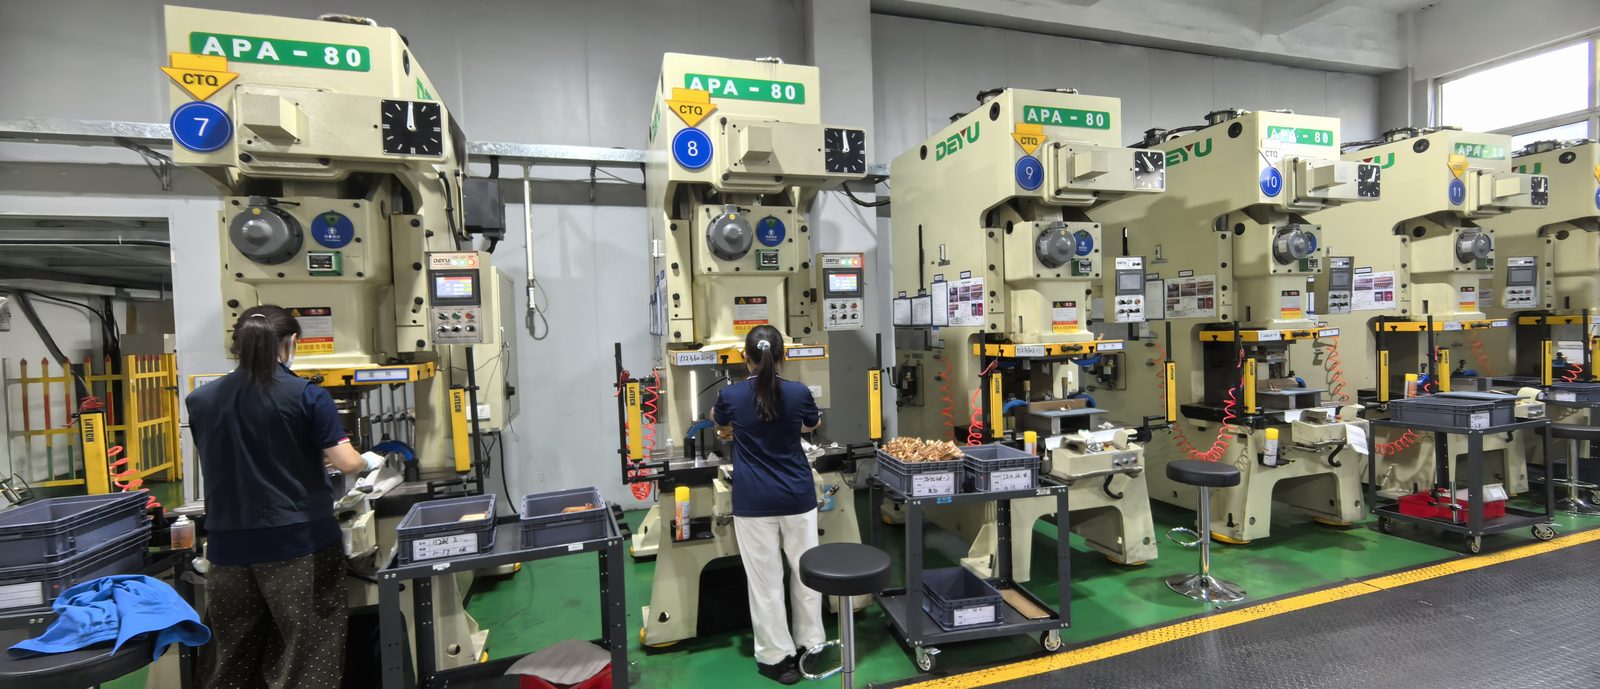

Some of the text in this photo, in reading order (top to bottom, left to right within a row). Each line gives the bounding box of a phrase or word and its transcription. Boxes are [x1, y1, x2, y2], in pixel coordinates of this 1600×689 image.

[202, 36, 280, 62] APA
[324, 46, 361, 67] 80
[182, 73, 219, 88] CTQ
[690, 76, 738, 96] APA
[771, 83, 796, 100] 80
[679, 104, 703, 116] CTQ
[1027, 108, 1063, 124] APA
[1085, 112, 1104, 127] 80
[194, 117, 210, 137] 7
[936, 121, 980, 162] DEYU
[1020, 136, 1038, 146] CTQ
[1314, 131, 1329, 144] 80
[687, 140, 699, 157] 8
[1166, 137, 1212, 168] EYU
[1025, 166, 1034, 180] 9
[1266, 176, 1278, 188] 10
[1452, 186, 1461, 198] 11
